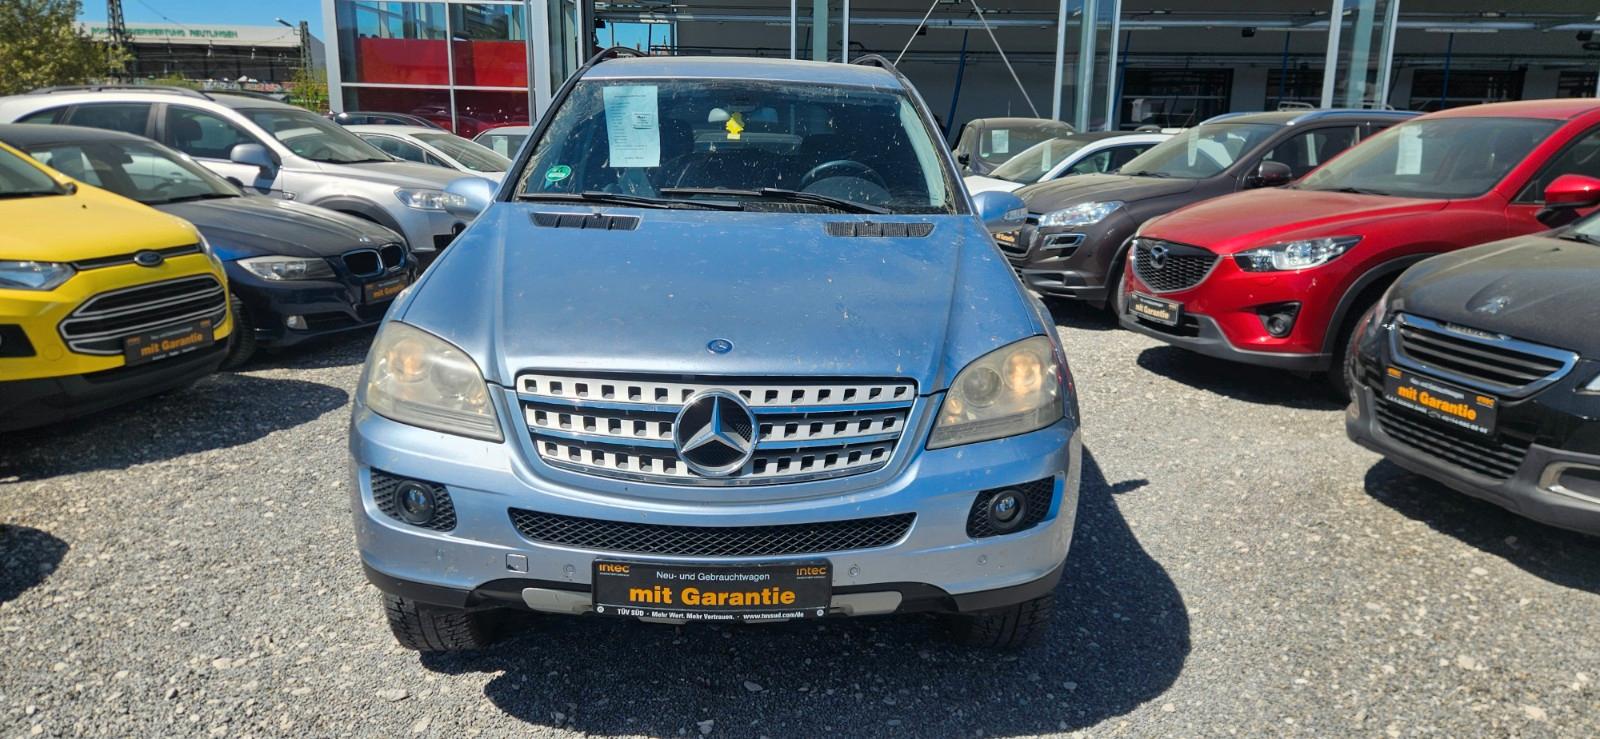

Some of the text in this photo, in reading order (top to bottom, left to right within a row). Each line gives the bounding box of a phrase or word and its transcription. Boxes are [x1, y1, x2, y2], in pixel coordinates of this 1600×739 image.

[140, 343, 160, 356] mit
[162, 333, 203, 351] Garantie
[1397, 386, 1418, 401] mit
[1419, 391, 1477, 420] Garantie
[599, 564, 630, 573] intec
[796, 567, 827, 576] intec
[656, 571, 770, 582] Neu- und Gebrauchtwagen
[629, 585, 796, 606] mit Garantie
[617, 608, 630, 616] TÜV
[631, 609, 644, 617] SÜD
